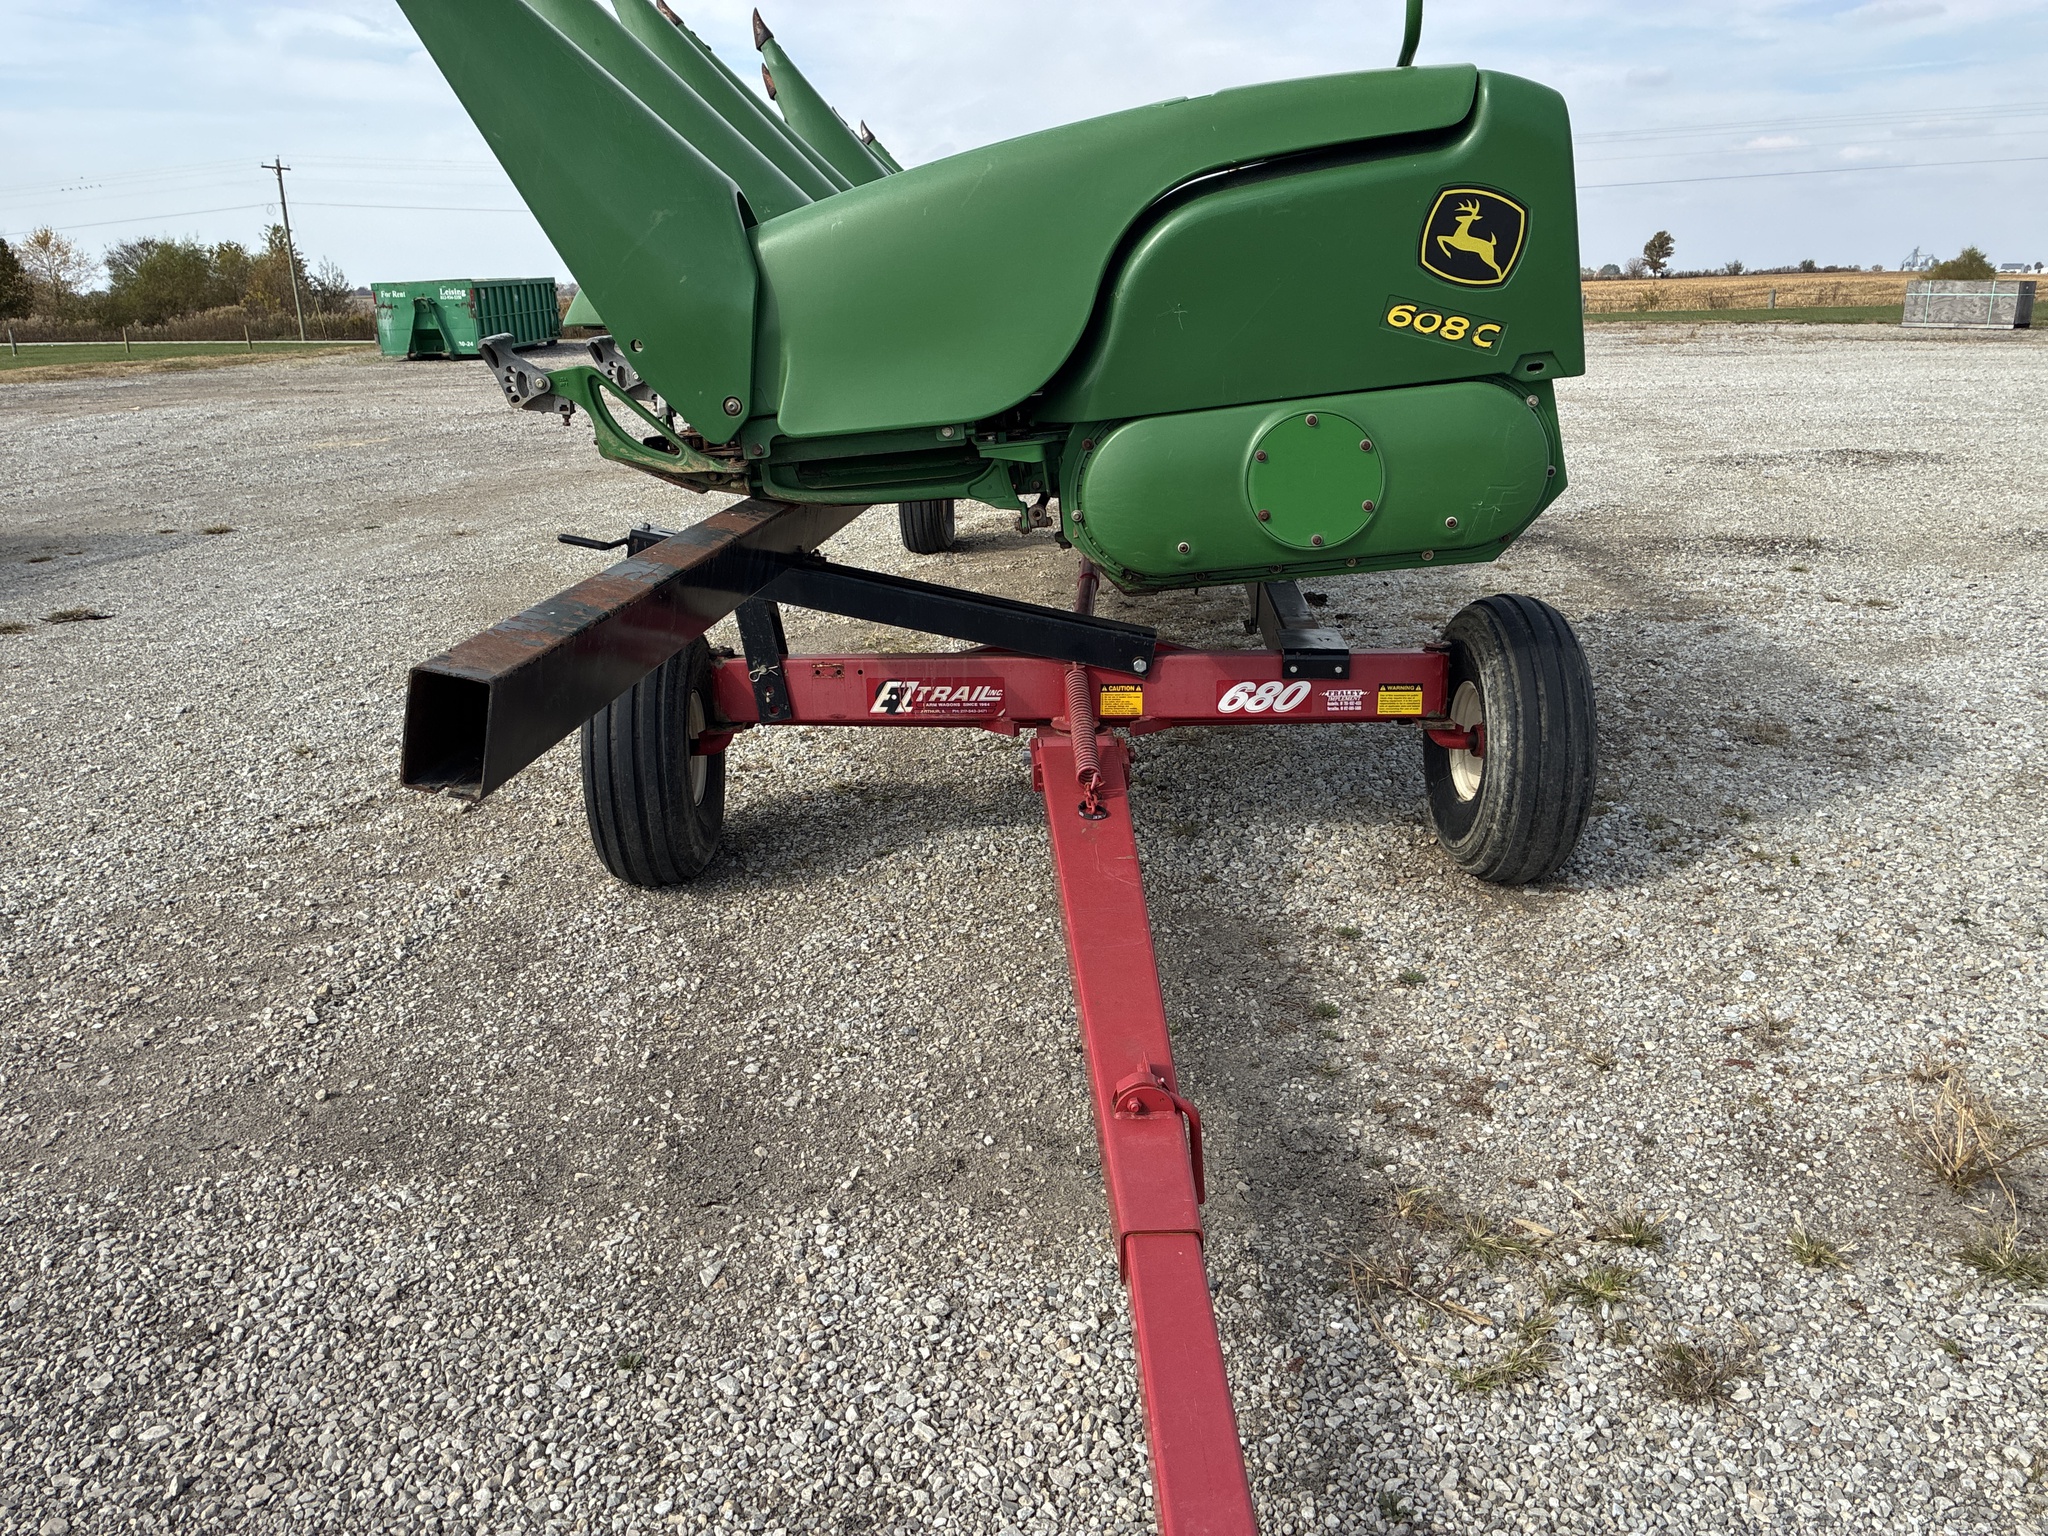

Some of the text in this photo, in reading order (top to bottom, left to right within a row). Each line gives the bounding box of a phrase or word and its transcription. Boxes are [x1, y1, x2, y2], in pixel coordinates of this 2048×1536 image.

[381, 290, 406, 298] For Rent
[439, 287, 466, 297] Leising
[1387, 304, 1502, 348] 608 C
[915, 686, 1002, 702] TRAIL
[1217, 680, 1312, 714] 680
